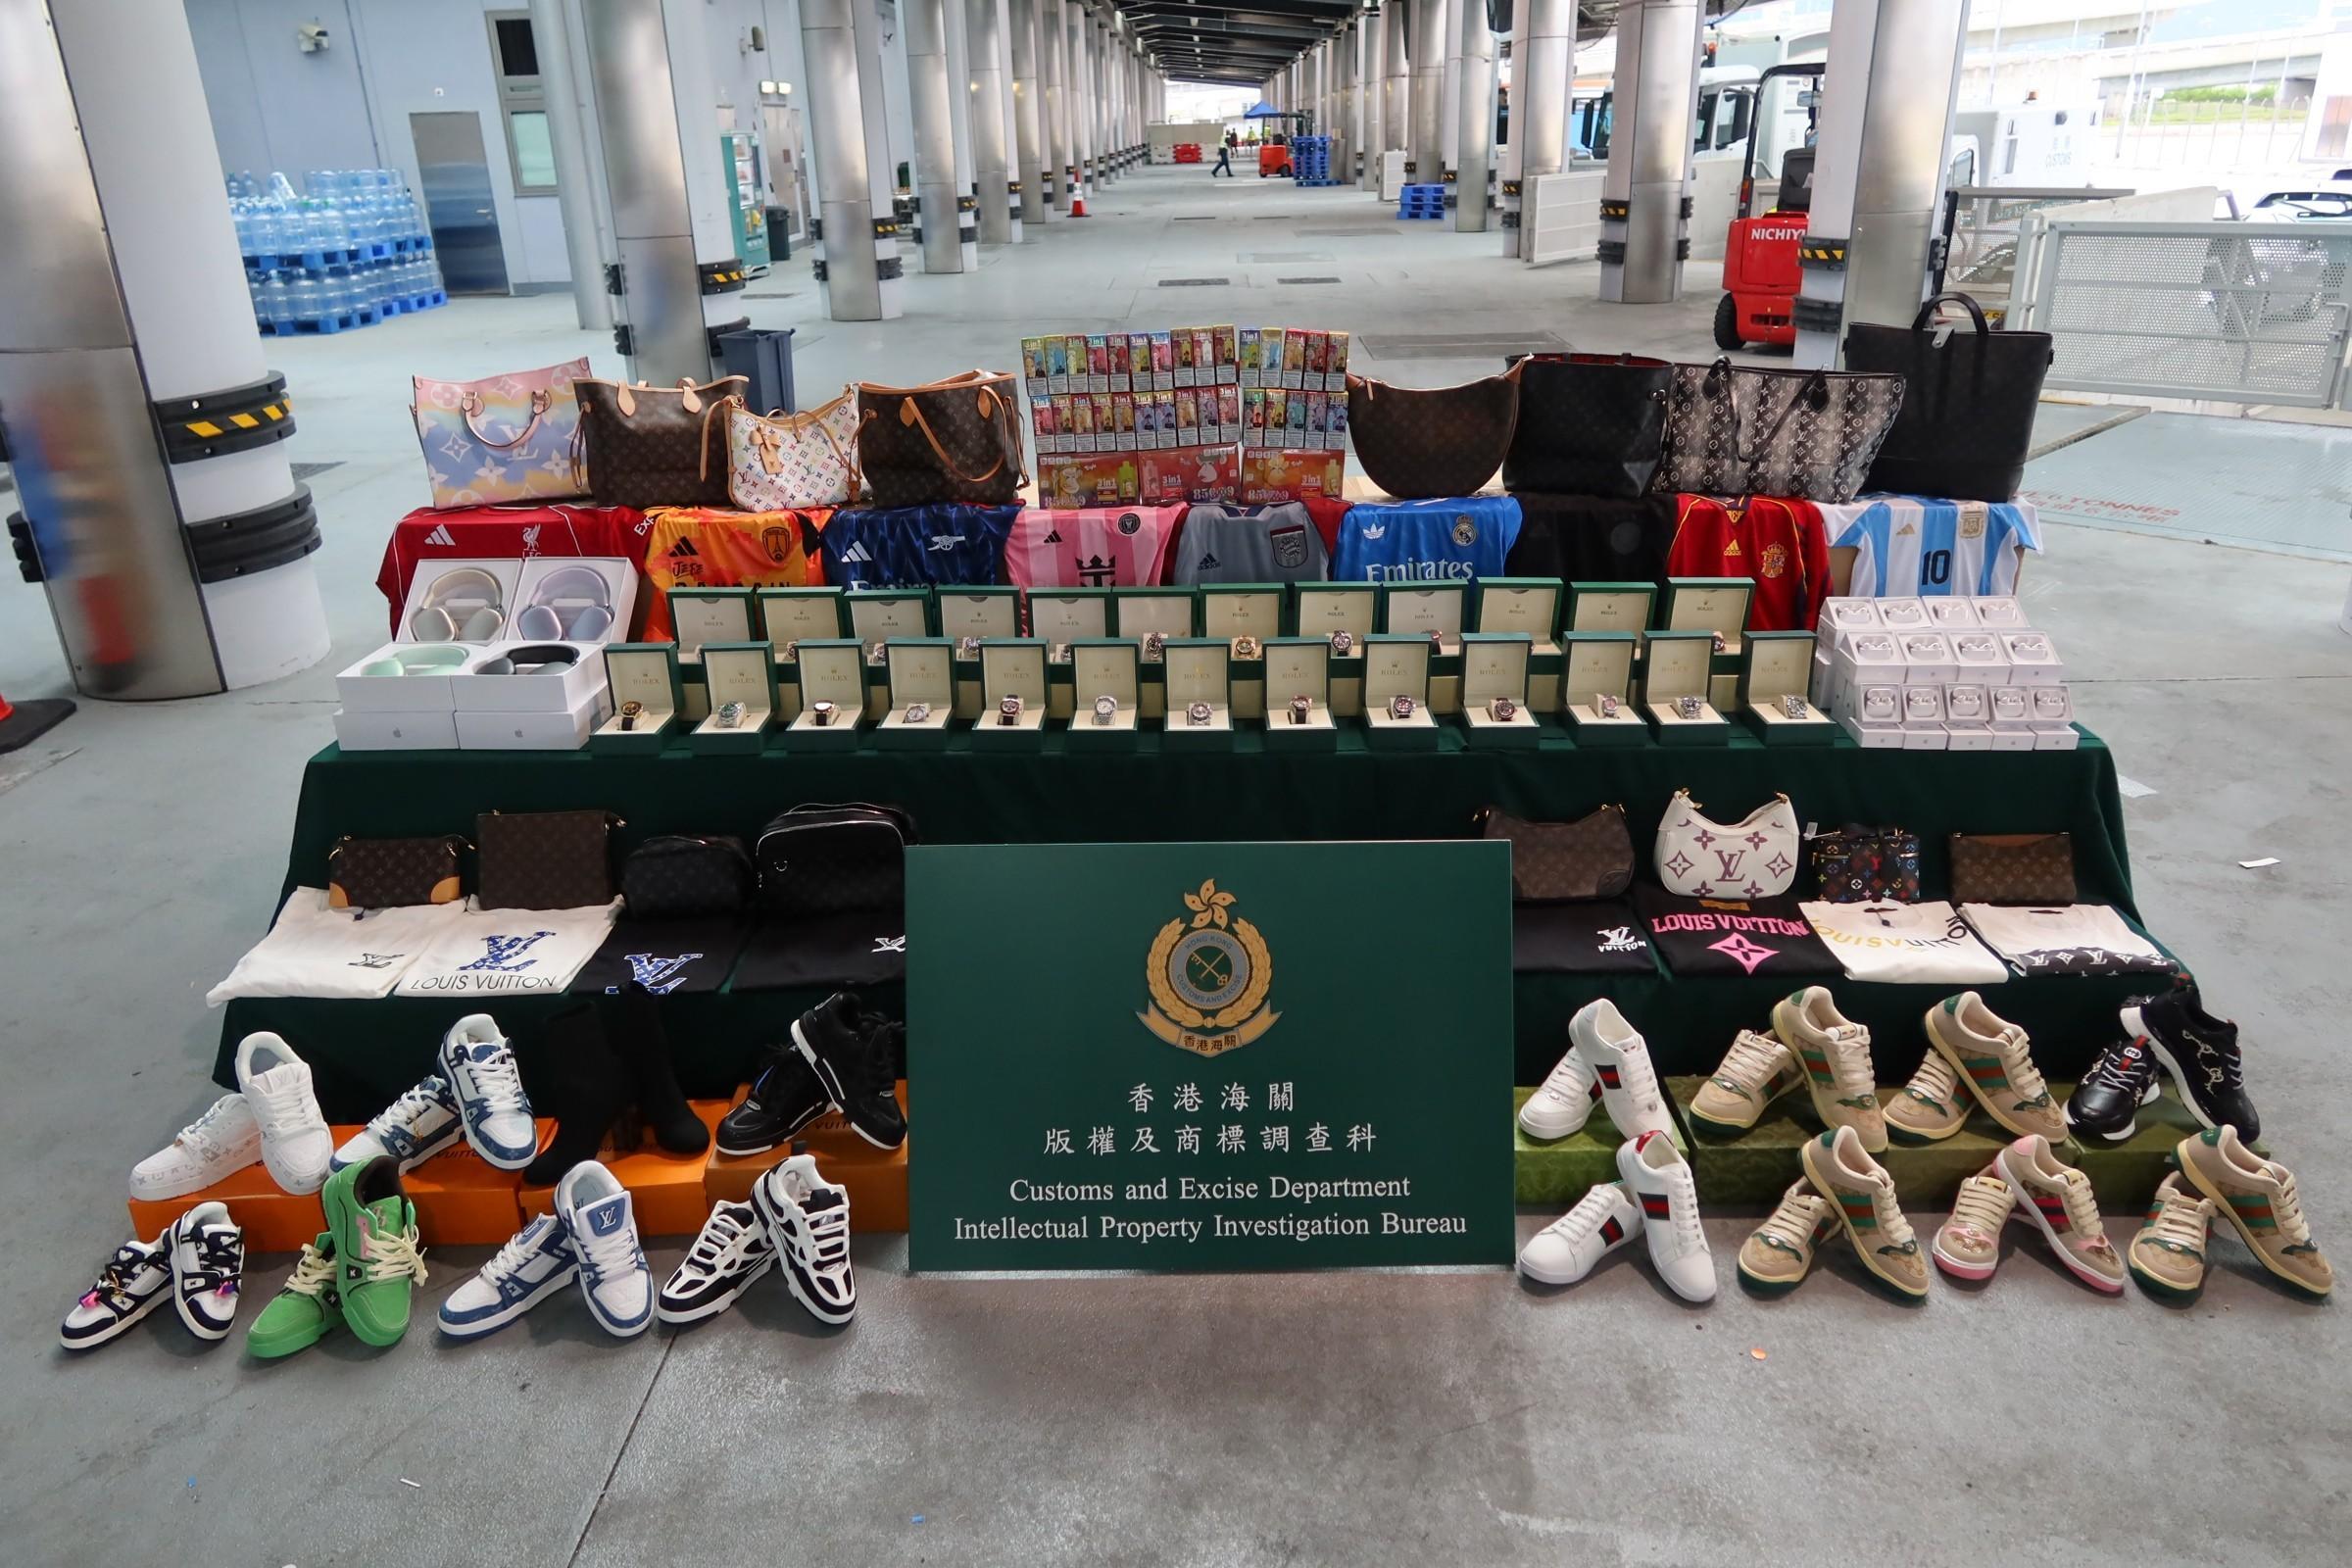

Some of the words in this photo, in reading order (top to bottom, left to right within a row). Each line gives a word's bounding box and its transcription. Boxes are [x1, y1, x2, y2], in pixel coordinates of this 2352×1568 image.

[1365, 557, 1474, 582] Emirates
[1921, 549, 1951, 586] 10
[1652, 914, 1715, 934] LOUIS
[1714, 913, 1810, 937] VUITTON
[1185, 934, 1208, 950] HONG
[1209, 934, 1234, 950] KONG
[1597, 941, 1647, 954] VUITTON
[411, 975, 468, 991] LOUIS
[472, 975, 558, 990] VUITTON
[1176, 973, 1204, 1003] CUSTOMS
[1222, 973, 1244, 999] EXCISE
[1183, 1035, 1237, 1052] 香港海關
[1128, 1081, 1294, 1113] 香港海關
[1043, 1121, 1377, 1156] 版權及商標調查科
[1009, 1179, 1114, 1201] Customs
[1125, 1177, 1168, 1200] and
[1179, 1176, 1258, 1200] Excise
[1269, 1176, 1411, 1204] Department
[955, 1215, 1089, 1240] Intellectual
[1100, 1215, 1202, 1244] Property
[1213, 1212, 1370, 1242] Investigation
[1381, 1212, 1467, 1235] Bureau
